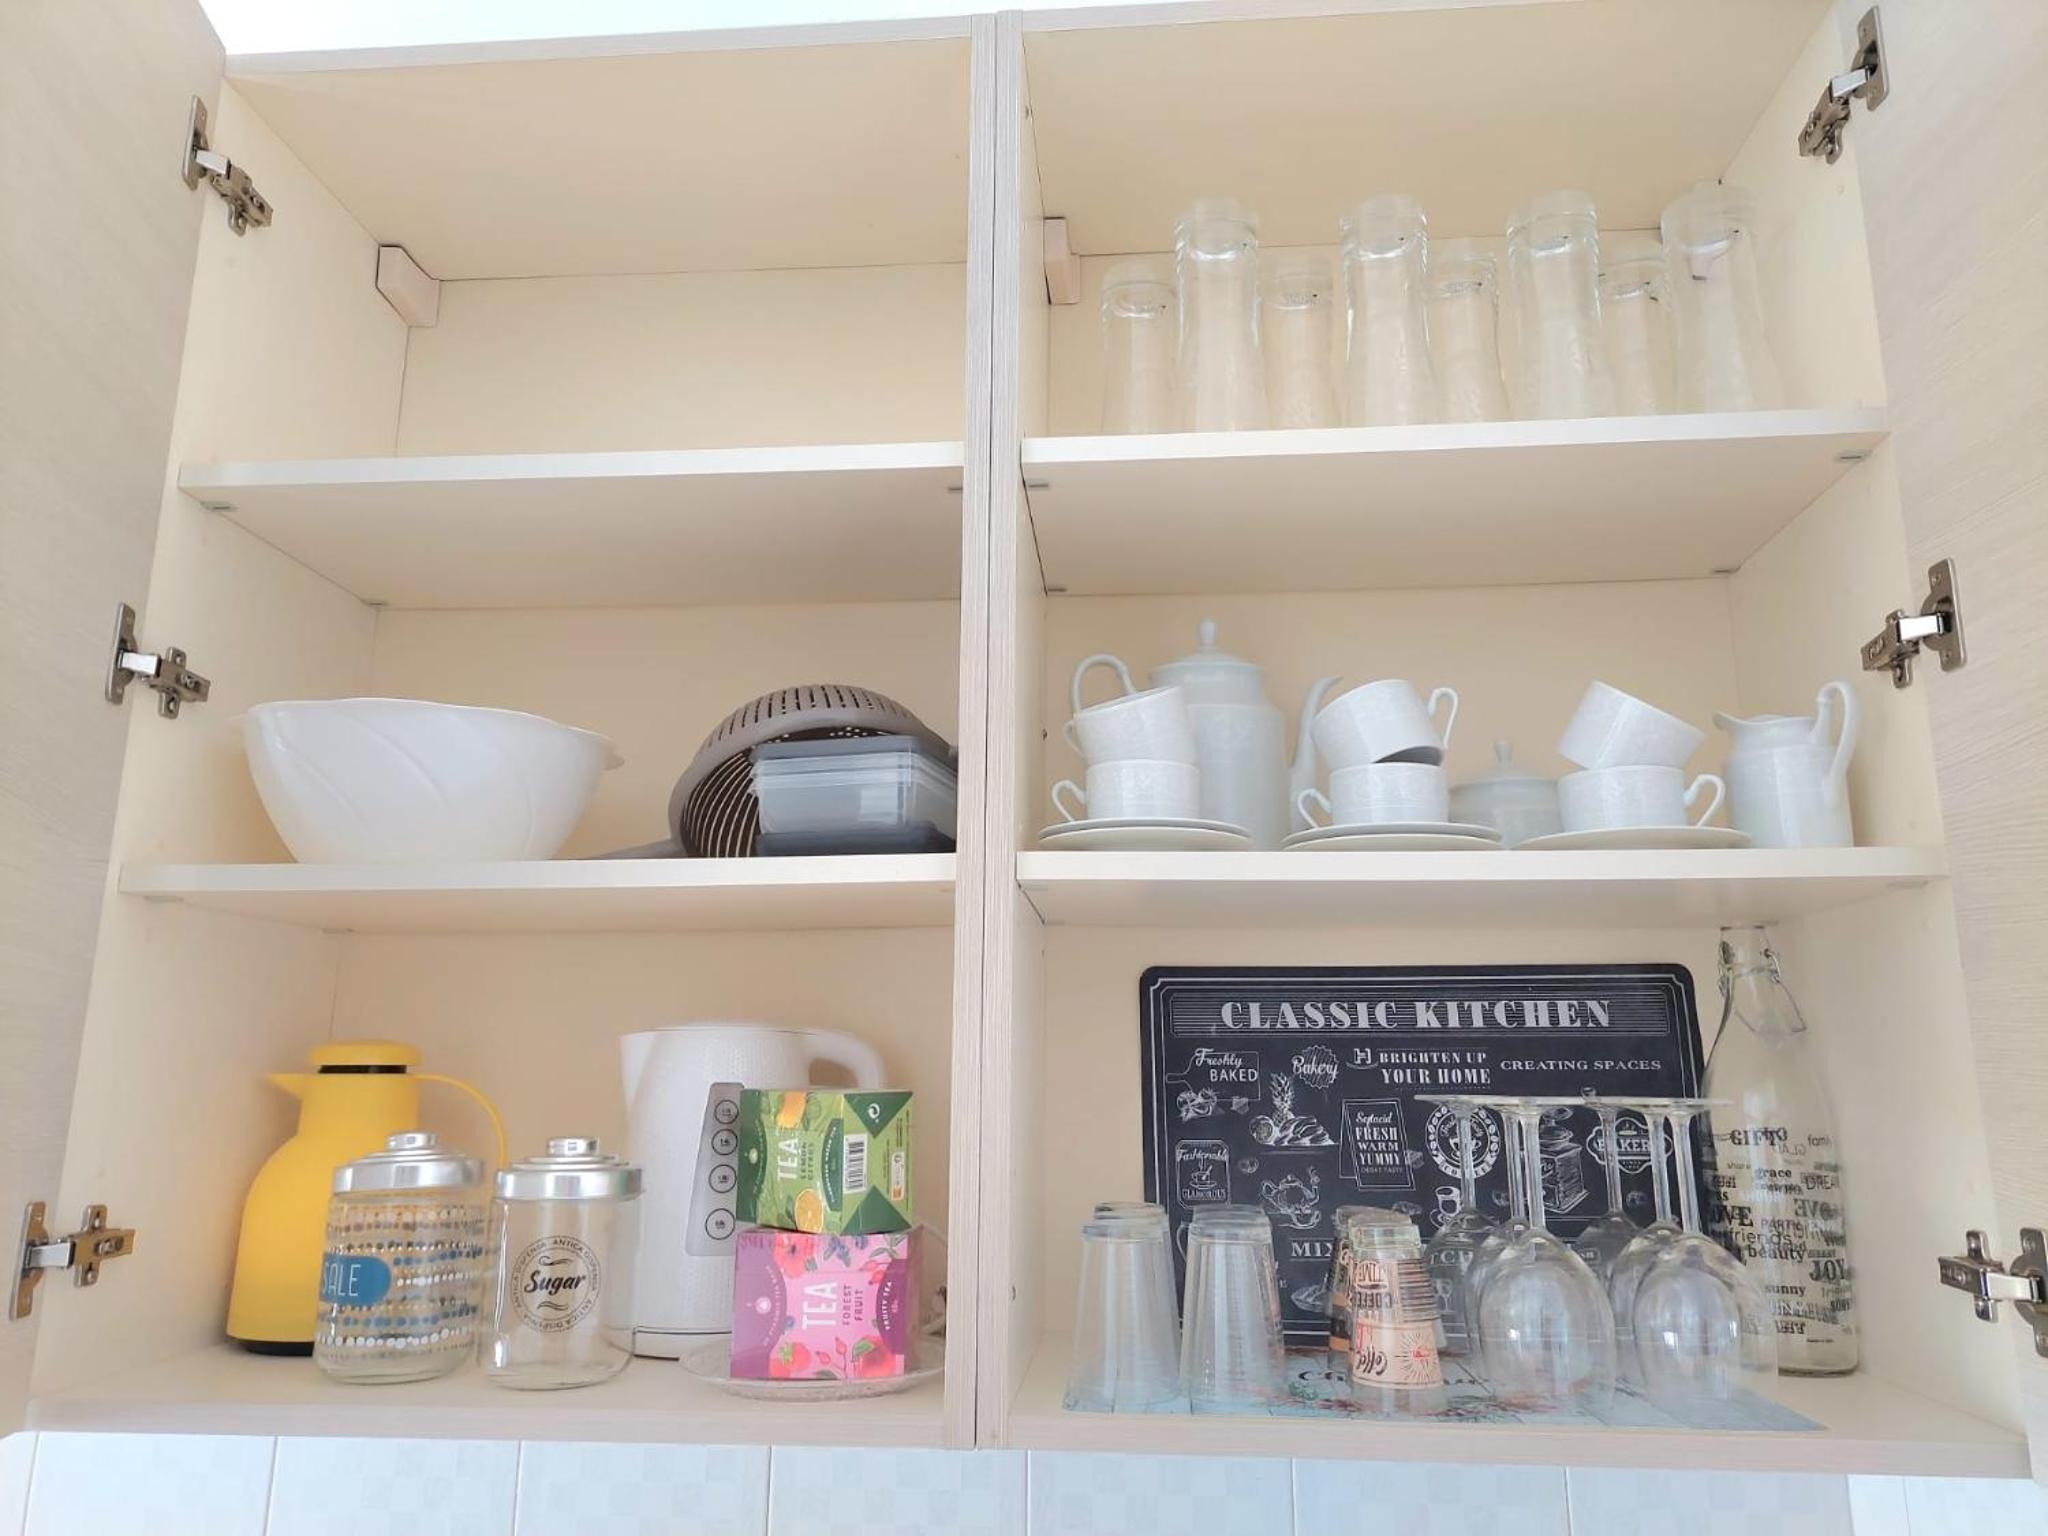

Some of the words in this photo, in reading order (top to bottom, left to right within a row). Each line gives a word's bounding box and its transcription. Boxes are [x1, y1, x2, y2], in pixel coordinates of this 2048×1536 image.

[1221, 1001, 1398, 1030] CLASSIC
[1414, 1000, 1610, 1029] KITCHEN
[1194, 1048, 1244, 1067] Freshly
[1292, 1055, 1339, 1079] Bakery
[1379, 1052, 1461, 1064] BRIGHTEN
[1466, 1052, 1487, 1064] UP
[1500, 1060, 1588, 1071] CREATING
[1594, 1060, 1662, 1071] SPACES
[1210, 1068, 1258, 1082] BAKED
[1381, 1068, 1431, 1084] YOUR
[1437, 1068, 1491, 1084] HOME
[1355, 1127, 1398, 1140] FRESH
[1357, 1142, 1399, 1151] WARM
[777, 1137, 800, 1181] TEA
[1360, 1153, 1400, 1165] YUMMY
[1748, 1244, 1806, 1263] beauty
[1808, 1259, 1846, 1281] JOY
[524, 1269, 587, 1296] Sugar
[1765, 1284, 1806, 1297] sunny
[802, 1281, 838, 1330] TEA
[843, 1284, 852, 1326] FOREST
[854, 1289, 863, 1321] FRUIT
